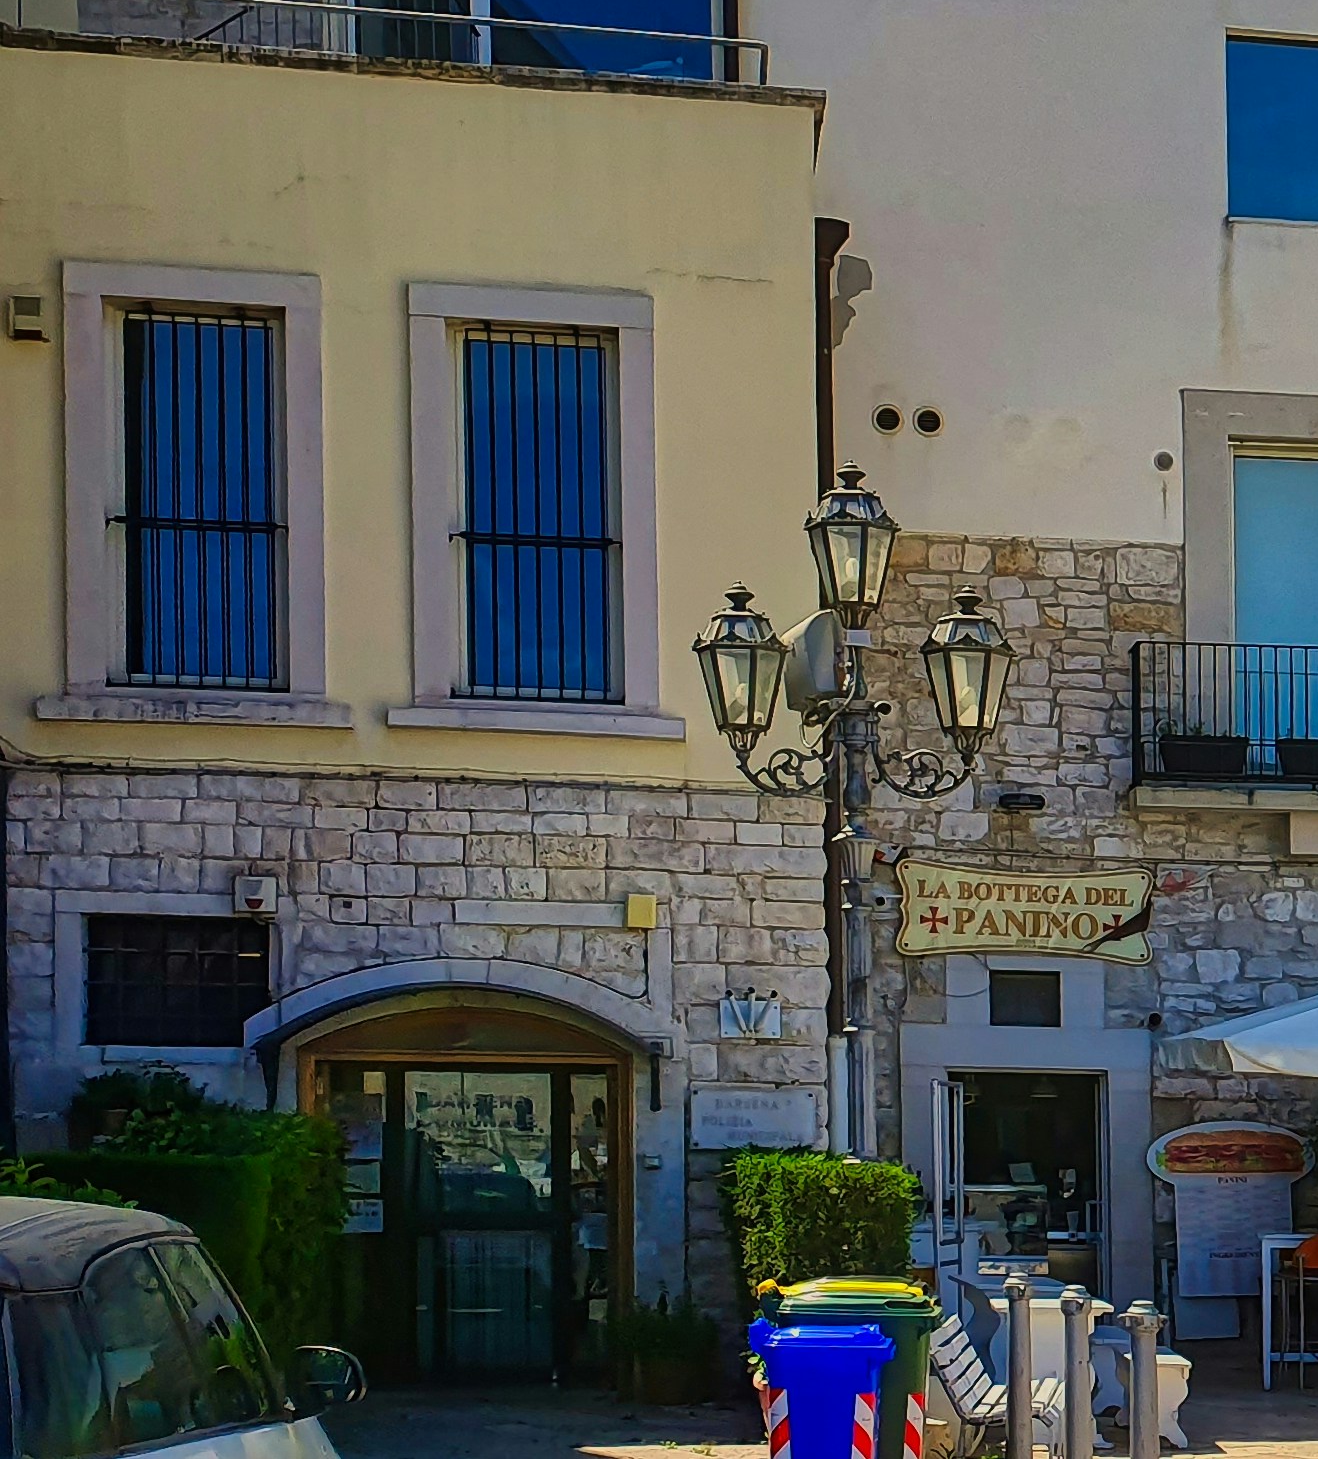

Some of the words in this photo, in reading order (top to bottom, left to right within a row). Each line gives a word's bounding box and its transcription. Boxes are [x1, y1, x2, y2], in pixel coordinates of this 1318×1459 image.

[916, 878, 951, 899] LA
[957, 880, 1079, 906] BOTTEGA
[1084, 887, 1135, 908] DEL
[952, 907, 1099, 940] PANINO
